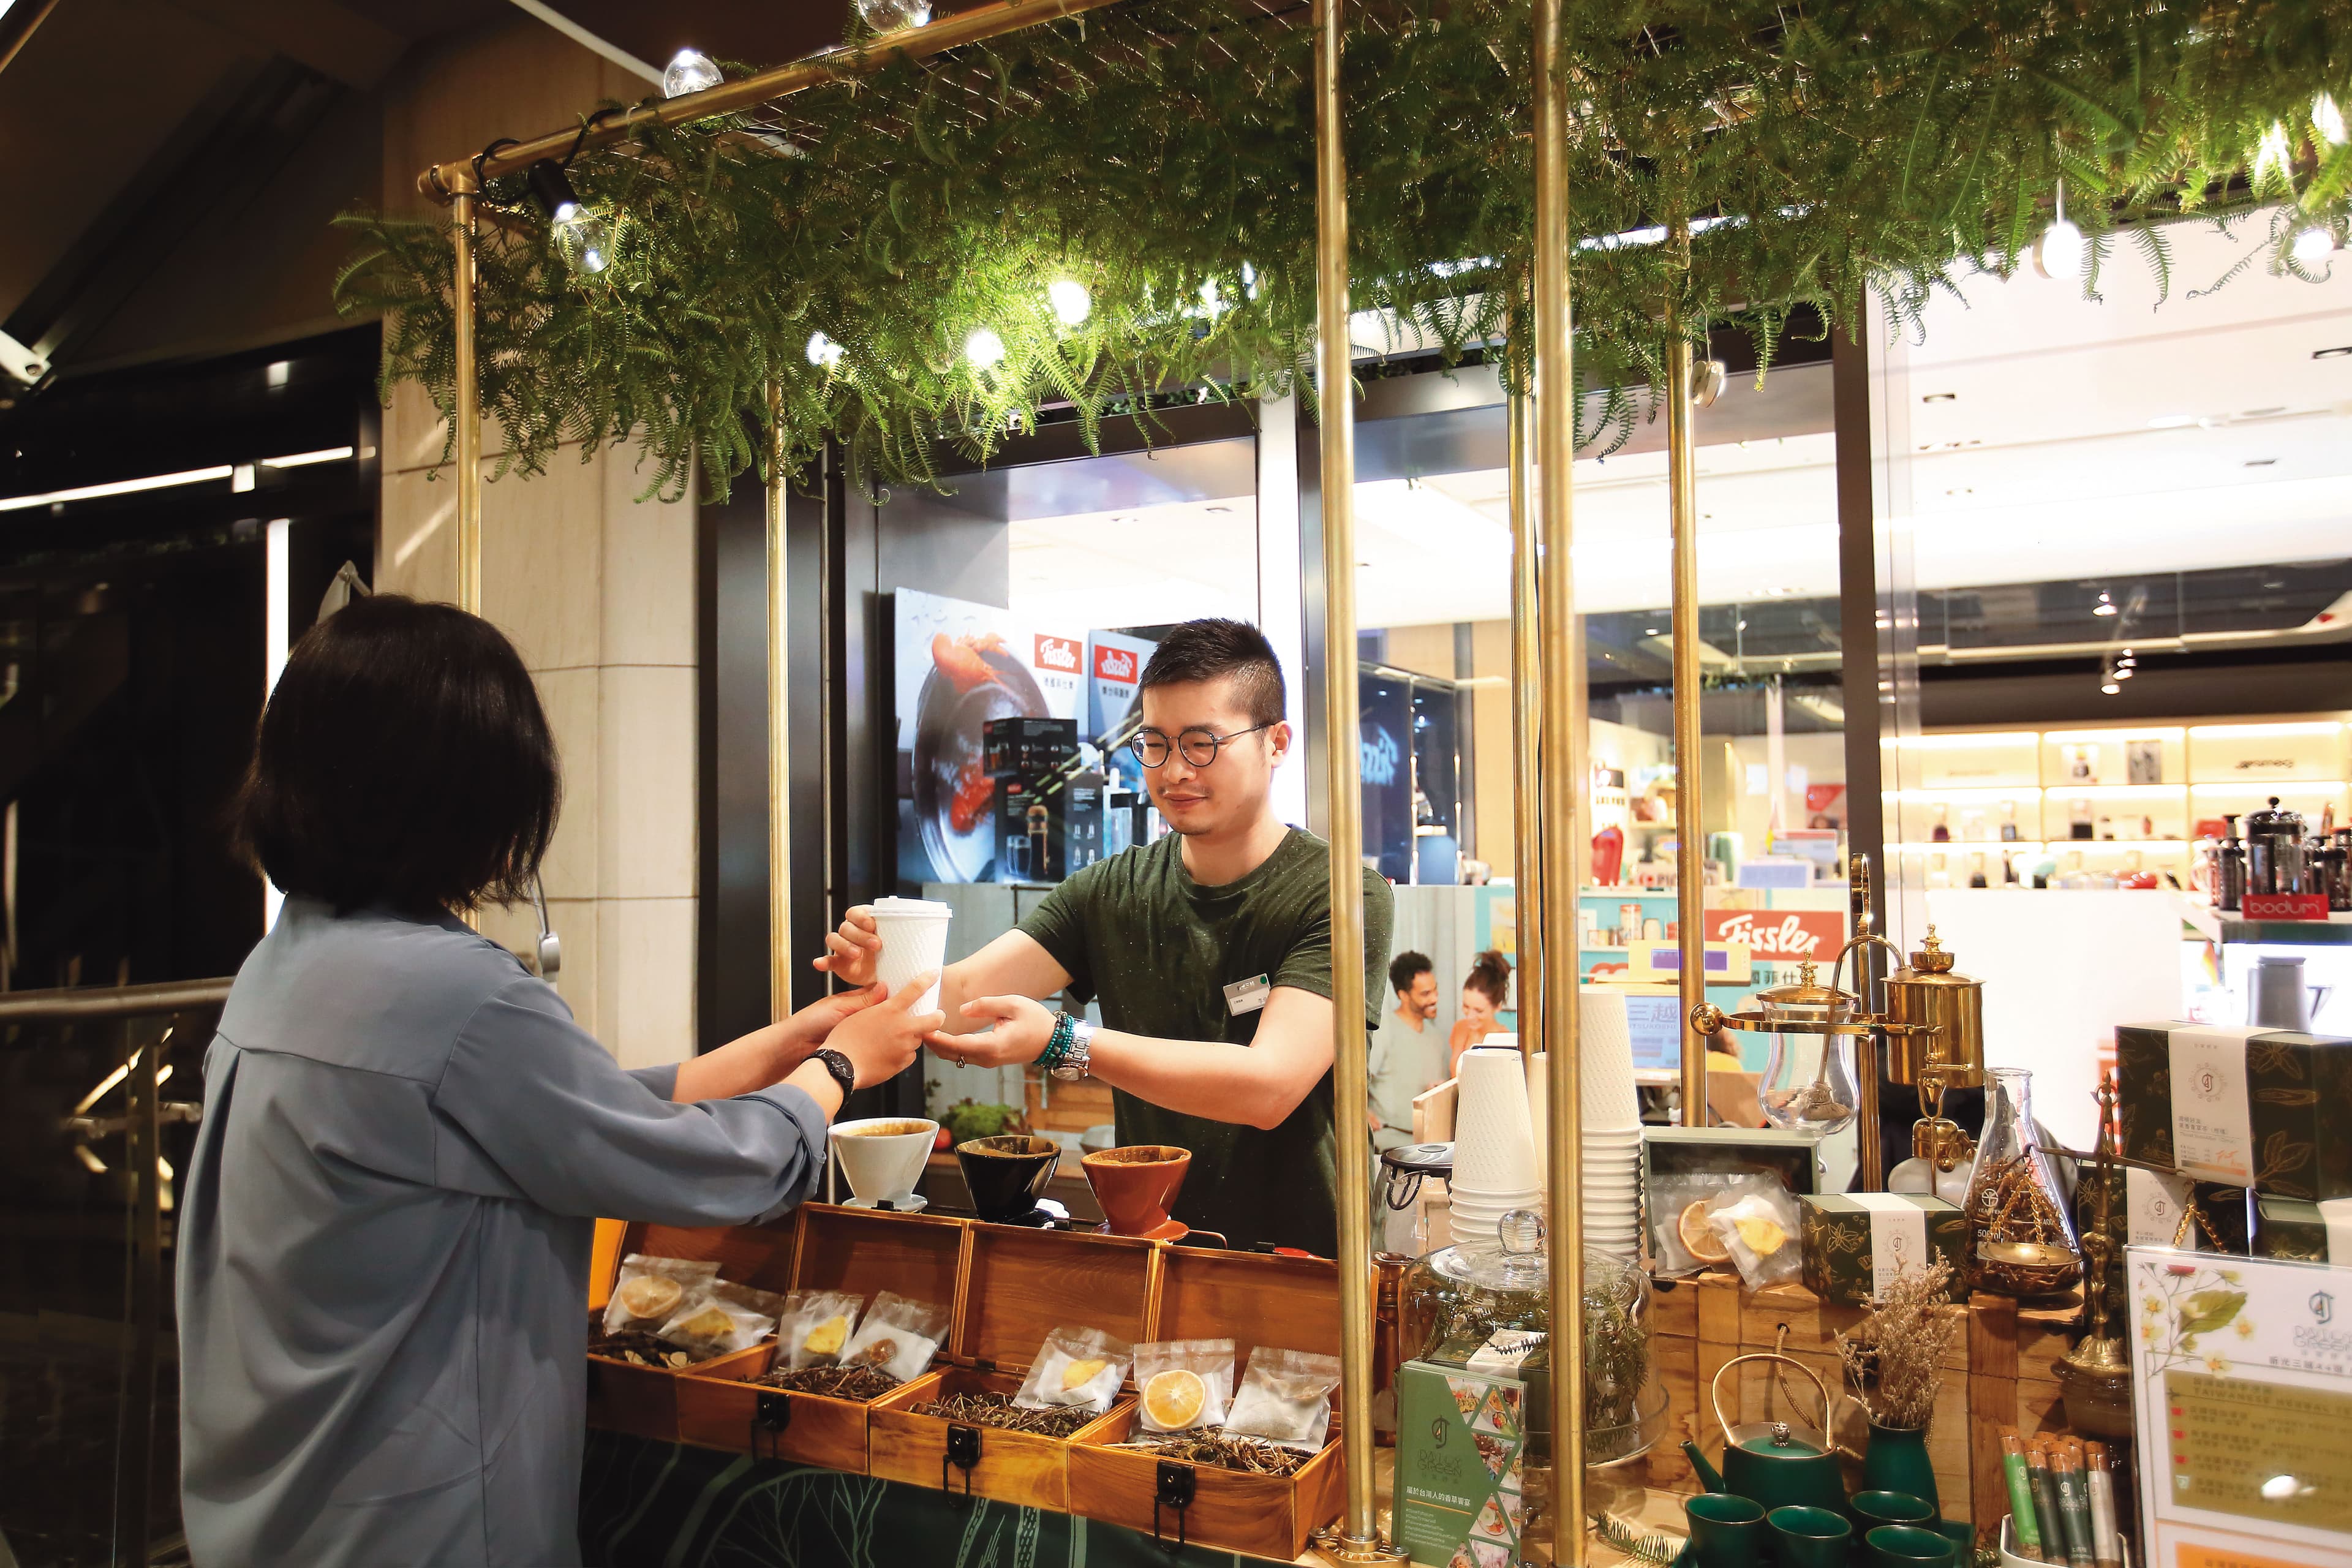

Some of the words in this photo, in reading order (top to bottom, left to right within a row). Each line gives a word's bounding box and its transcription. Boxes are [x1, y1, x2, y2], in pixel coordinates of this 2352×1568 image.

[1040, 638, 1076, 669] Fissler
[2249, 900, 2320, 914] bodum
[1718, 913, 1820, 954] Fissler
[1406, 1486, 1471, 1506] 屬於台灣人的香草饗宴
